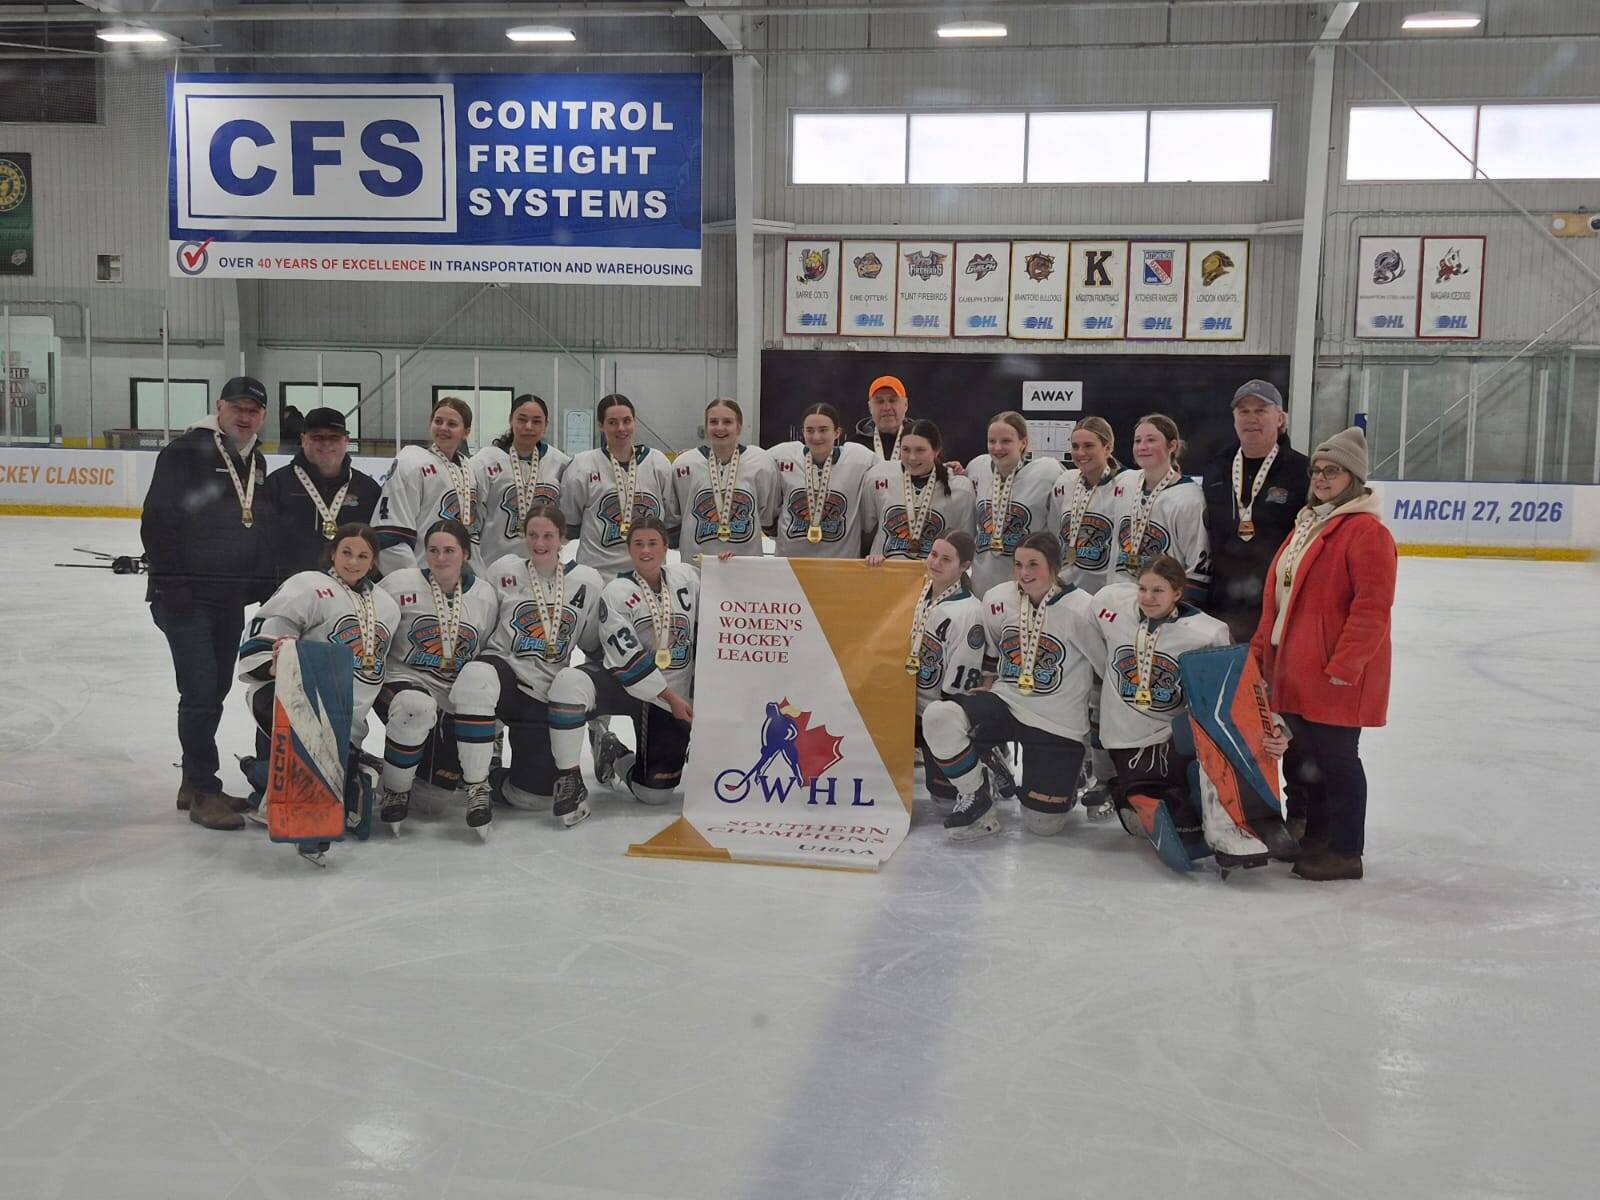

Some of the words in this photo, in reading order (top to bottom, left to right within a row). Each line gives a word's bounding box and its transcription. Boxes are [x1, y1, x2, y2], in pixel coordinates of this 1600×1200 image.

[467, 100, 674, 132] CONTROL
[208, 118, 424, 197] CFS
[468, 144, 658, 175] FREIGHT
[467, 187, 668, 219] SYSTEMS
[218, 257, 254, 269] OVER
[257, 258, 272, 270] 40
[275, 258, 318, 270] YEARS
[321, 259, 339, 270] OF
[342, 259, 426, 271] EXCELLENCE
[429, 260, 442, 271] IN
[446, 260, 562, 273] TRANSPORTATION
[566, 262, 592, 274] AND
[596, 262, 694, 276] WAREHOUSING
[1085, 250, 1113, 286] K
[800, 313, 828, 326] OHL
[855, 313, 885, 327] OHL
[911, 314, 940, 327] OHL
[967, 314, 998, 327] OHL
[1023, 316, 1054, 329] OHL
[1082, 316, 1114, 329] OHL
[1141, 317, 1173, 330] OHL
[1201, 317, 1233, 330] OHL
[1371, 315, 1405, 328] OHL
[1435, 315, 1468, 328] OHL
[1031, 390, 1074, 402] AWAY
[46, 466, 115, 486] CLASSIC
[1393, 499, 1467, 521] MARCH
[1471, 500, 1500, 524] 27,
[1508, 501, 1564, 523] 2026
[569, 583, 587, 609] A
[676, 587, 692, 612] C
[720, 600, 802, 615] ONTARIO
[719, 616, 803, 631] WOMEN'S
[935, 617, 952, 642] A
[607, 626, 639, 657] 13
[718, 631, 794, 647] HOCKEY
[717, 648, 790, 664] LEAGUE
[951, 664, 982, 690] 18
[273, 733, 287, 792] CCM
[713, 768, 876, 806] OWHL
[706, 826, 885, 844] CHAMPIONS
[726, 820, 891, 836] SOUTHERN
